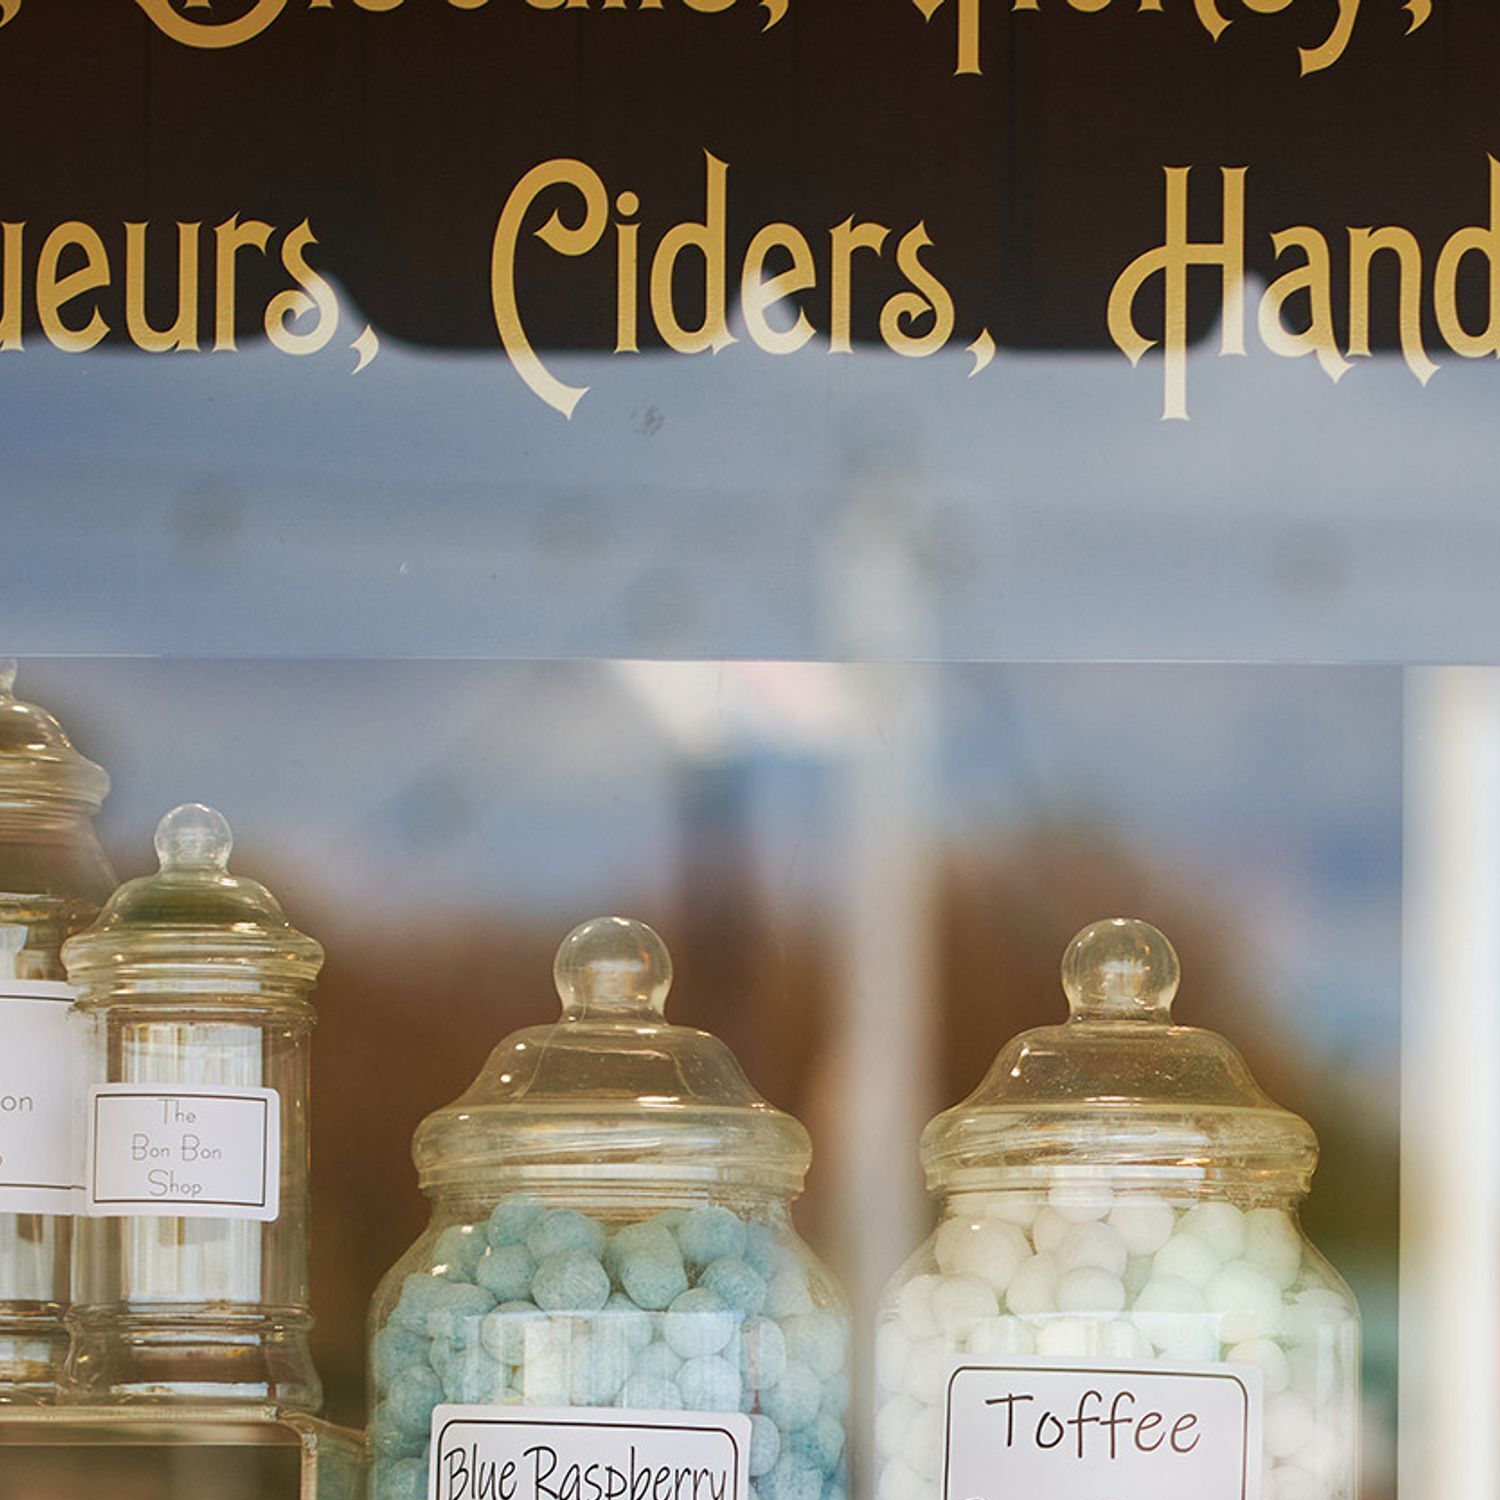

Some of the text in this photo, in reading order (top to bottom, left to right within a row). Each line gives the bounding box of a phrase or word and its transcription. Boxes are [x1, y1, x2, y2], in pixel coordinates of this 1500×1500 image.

[491, 148, 996, 420] Ciders,
[157, 1097, 197, 1125] The
[131, 1133, 222, 1162] Bon Bon
[147, 1168, 203, 1197] Shop
[985, 1389, 1201, 1459] Toffee
